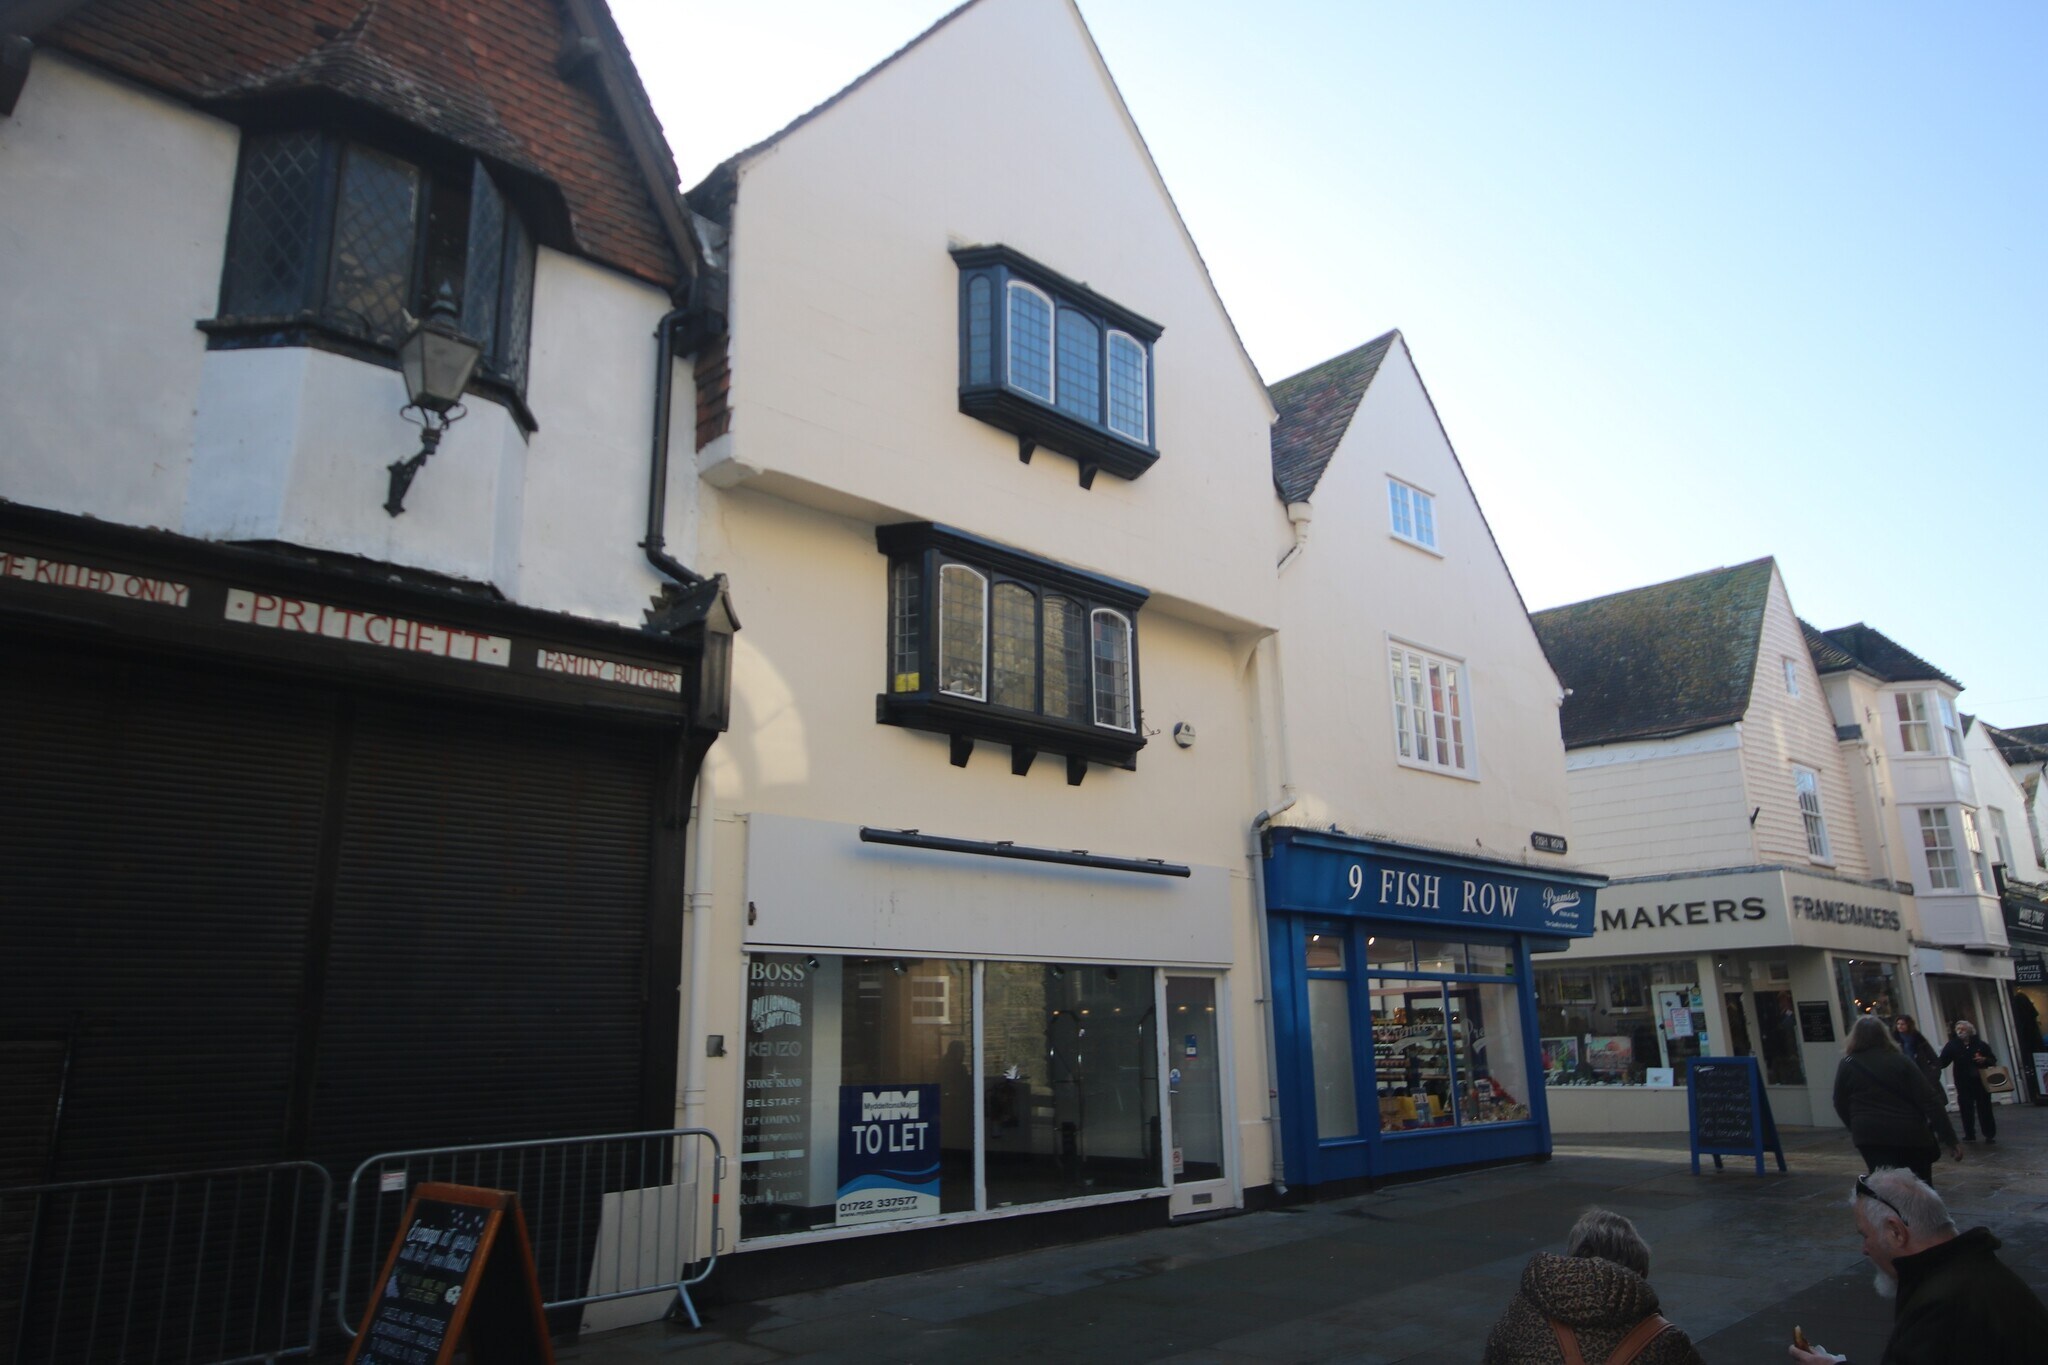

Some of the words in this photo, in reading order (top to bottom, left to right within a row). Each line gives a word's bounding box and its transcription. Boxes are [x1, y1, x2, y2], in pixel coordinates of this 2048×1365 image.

[34, 558, 115, 594] KILLED
[123, 574, 189, 608] ONLY
[252, 592, 489, 662] PRITCHETT
[544, 650, 606, 679] FAMILY
[614, 664, 677, 693] BUTCHER
[1348, 864, 1363, 900] 9
[1379, 868, 1441, 909] FISH
[1461, 880, 1519, 918] ROW
[1542, 886, 1580, 909] Premier
[1594, 897, 1767, 932] MAKERS
[1792, 895, 1901, 931] FRAMEMAKERS
[751, 962, 805, 981] BOSS
[2017, 964, 2040, 972] WHITE
[2019, 973, 2041, 981] STUFF
[748, 1040, 802, 1057] KENZO
[746, 1079, 773, 1089] STONE
[775, 1078, 802, 1088] ISLAND
[746, 1097, 802, 1108] BELSTAFF
[852, 1124, 882, 1155] TO
[889, 1122, 928, 1152] LET
[839, 1200, 874, 1212] 01722
[876, 1195, 918, 1208] 337577
